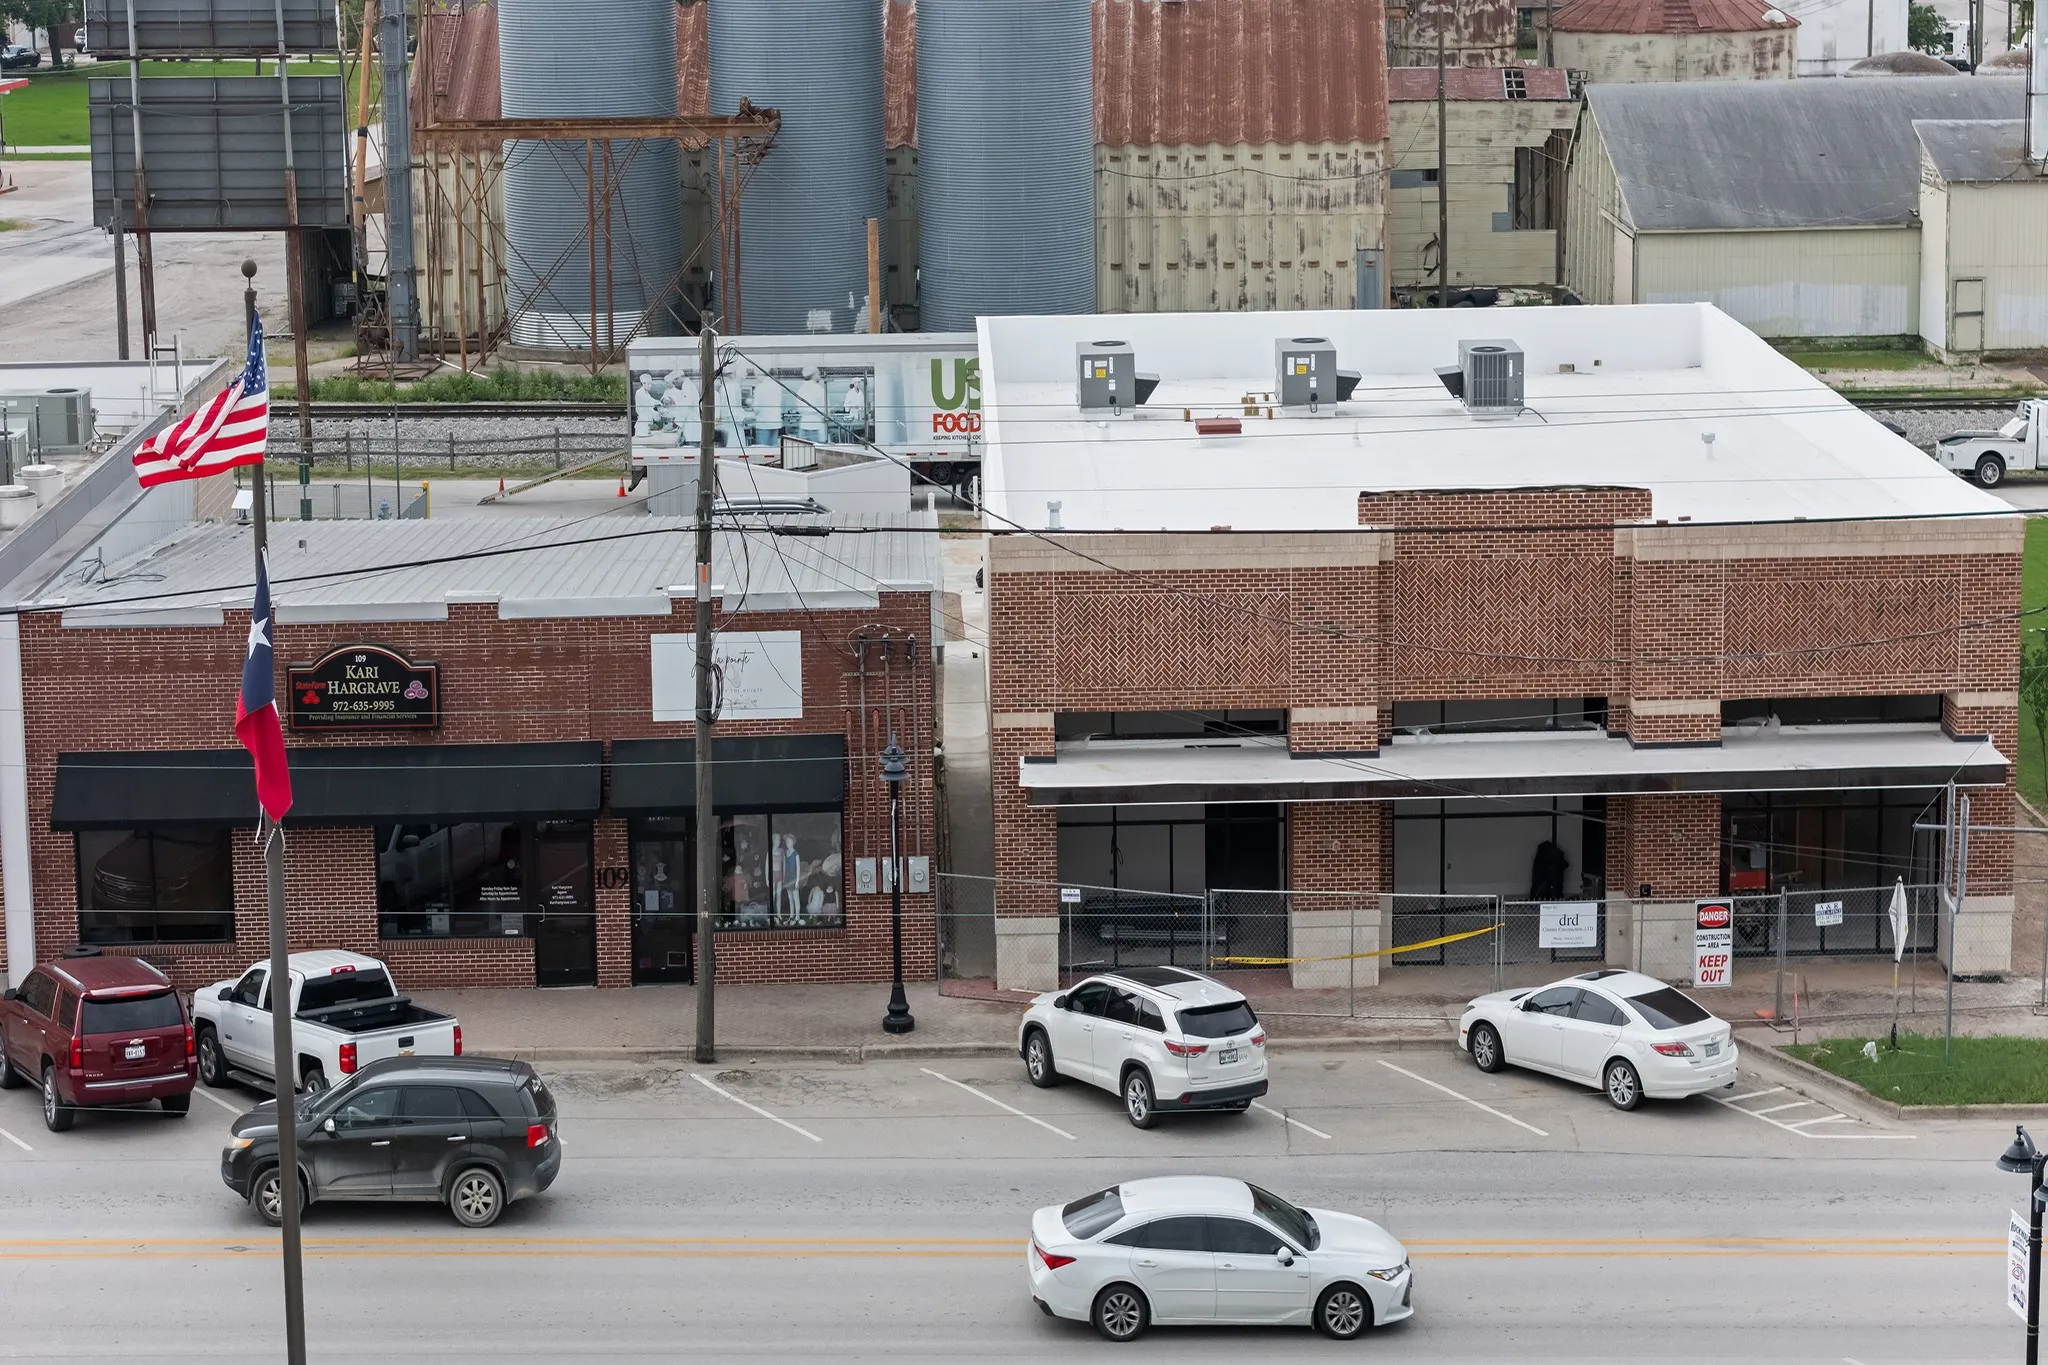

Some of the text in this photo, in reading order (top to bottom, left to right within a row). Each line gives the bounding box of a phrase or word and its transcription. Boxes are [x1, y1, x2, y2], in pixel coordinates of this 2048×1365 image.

[355, 654, 367, 663] 109
[345, 665, 379, 679] KARI
[327, 681, 401, 695] HARGRAVE
[332, 700, 395, 712] 972-635-9995
[309, 714, 334, 722] Providing
[598, 867, 628, 889] 109
[1558, 913, 1579, 926] drd
[1700, 911, 1728, 921] DANGER
[1696, 933, 1731, 941] CONSTRUCTION
[1699, 954, 1728, 968] KEEP
[1701, 969, 1724, 983] OUT
